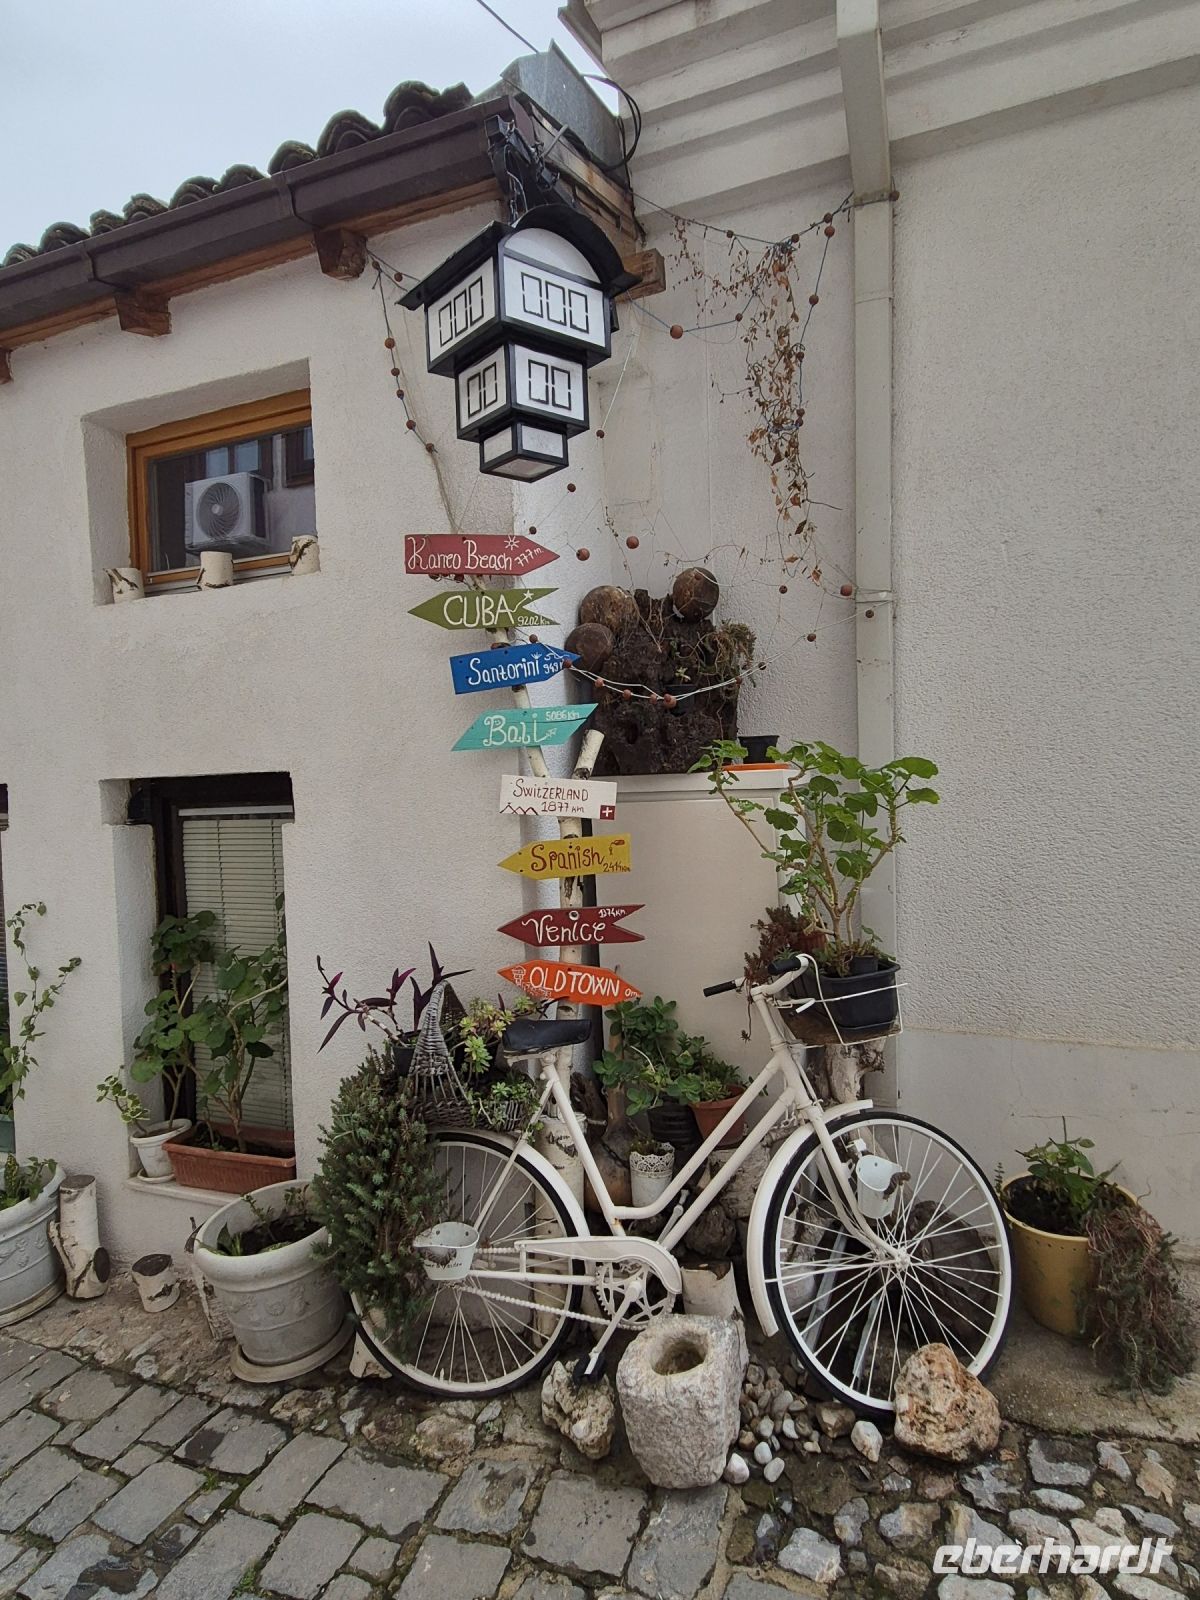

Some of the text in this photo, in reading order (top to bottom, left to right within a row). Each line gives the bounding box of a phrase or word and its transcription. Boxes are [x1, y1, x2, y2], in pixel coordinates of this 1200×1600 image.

[463, 540, 513, 571] Beach
[443, 594, 515, 627] CUBA
[467, 653, 540, 686] Santorini
[483, 712, 544, 747] Bali
[541, 801, 569, 813] 1877
[531, 844, 604, 872] Spanish
[522, 911, 606, 944] Venice
